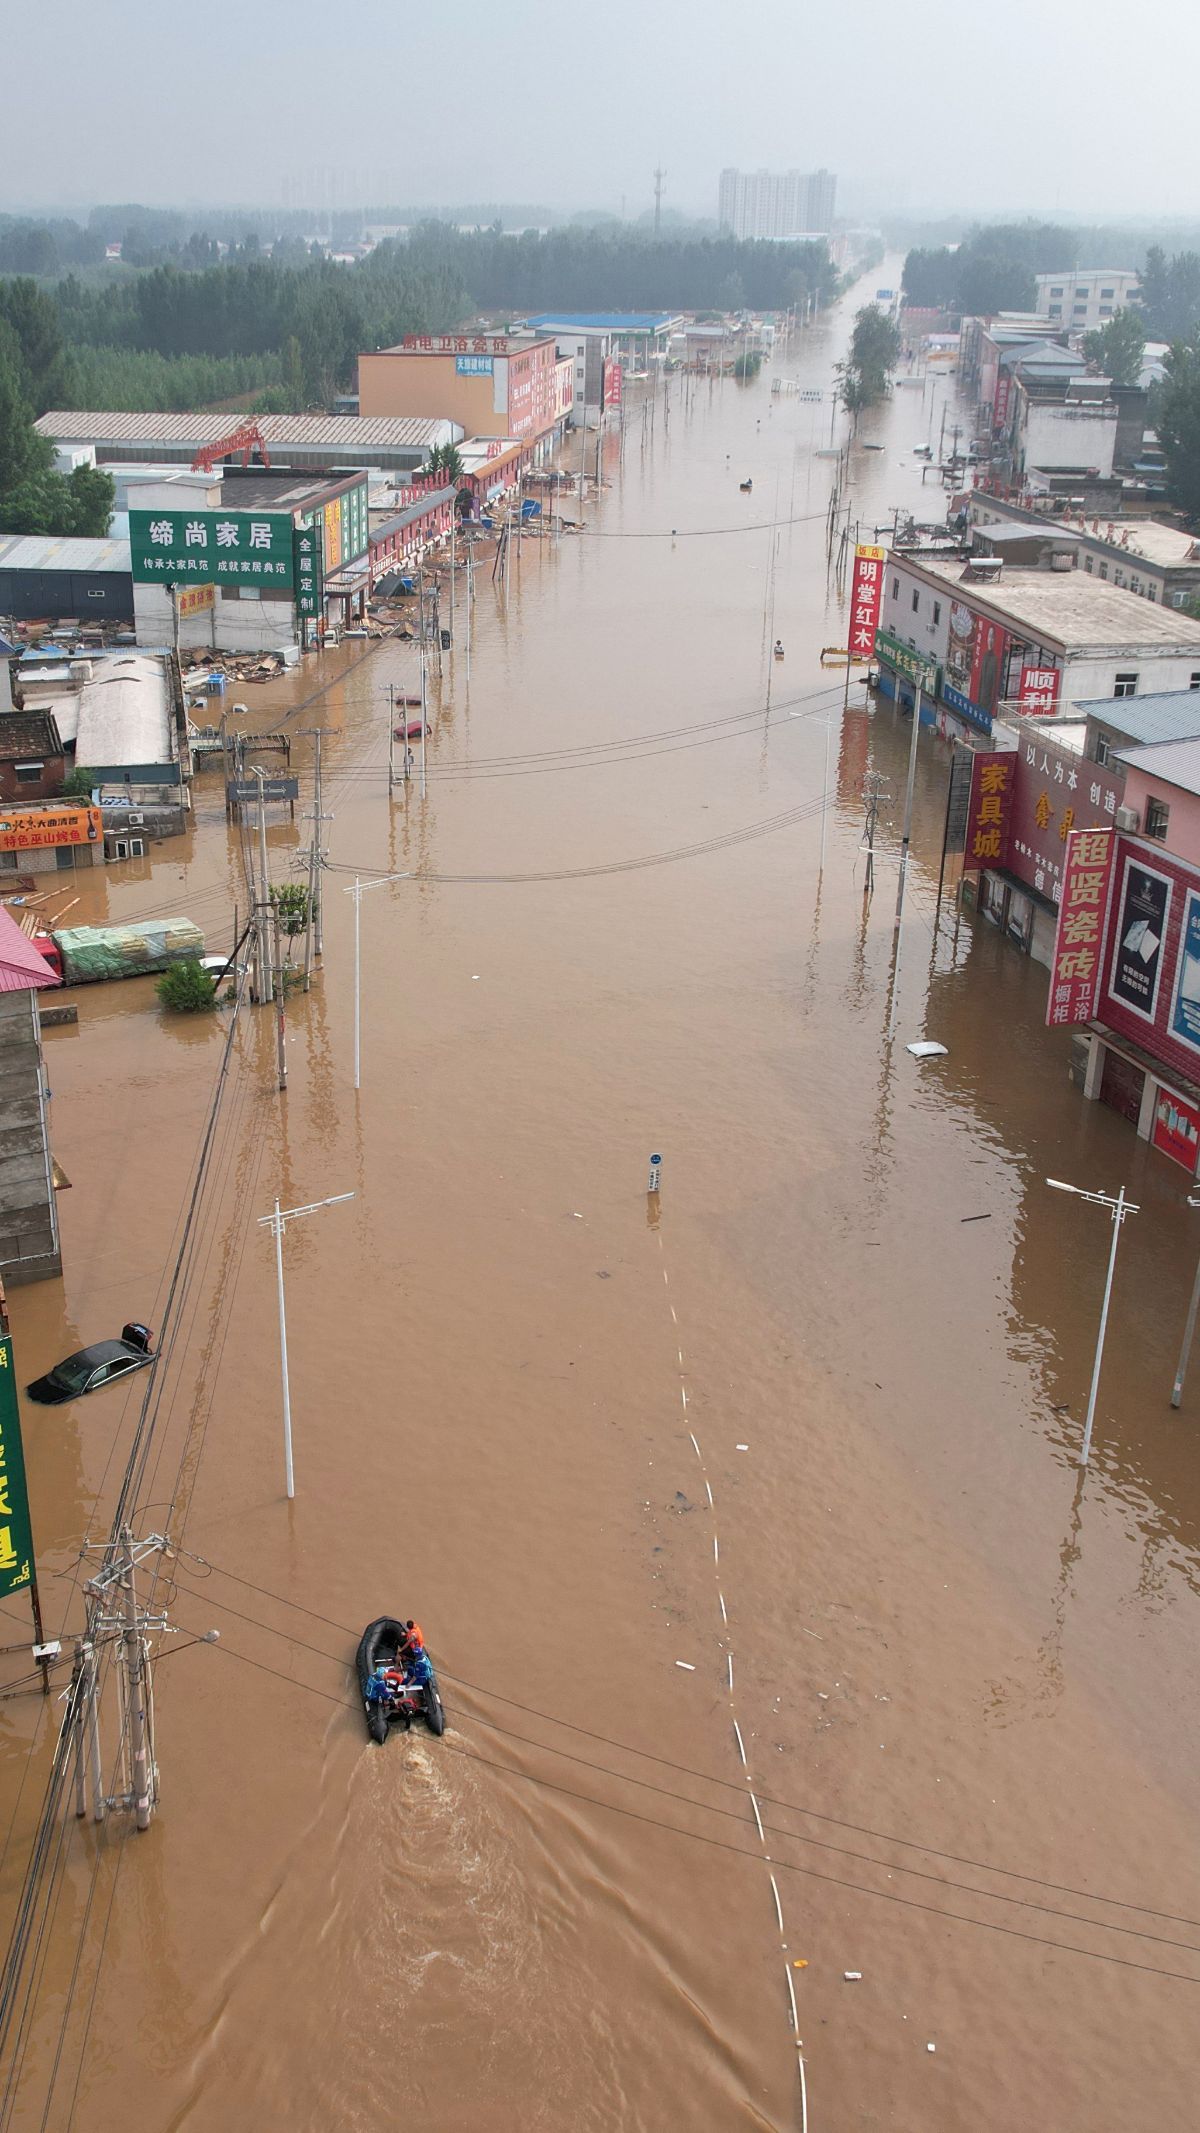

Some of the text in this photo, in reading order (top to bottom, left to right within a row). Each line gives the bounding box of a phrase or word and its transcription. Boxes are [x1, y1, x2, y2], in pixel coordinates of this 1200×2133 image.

[149, 520, 273, 550] 缔尚家居
[144, 557, 286, 575] 传承大家风范 成就家居典范
[299, 538, 314, 612] 全屋定制
[854, 560, 877, 648] 明堂红木
[1023, 670, 1056, 719] 顺利
[1026, 744, 1079, 791] 以人为本
[972, 763, 1009, 858] 家具城
[1056, 833, 1110, 981] 超贤瓷砖
[1053, 984, 1072, 1023] 橱柜
[1074, 983, 1092, 1021] 卫浴
